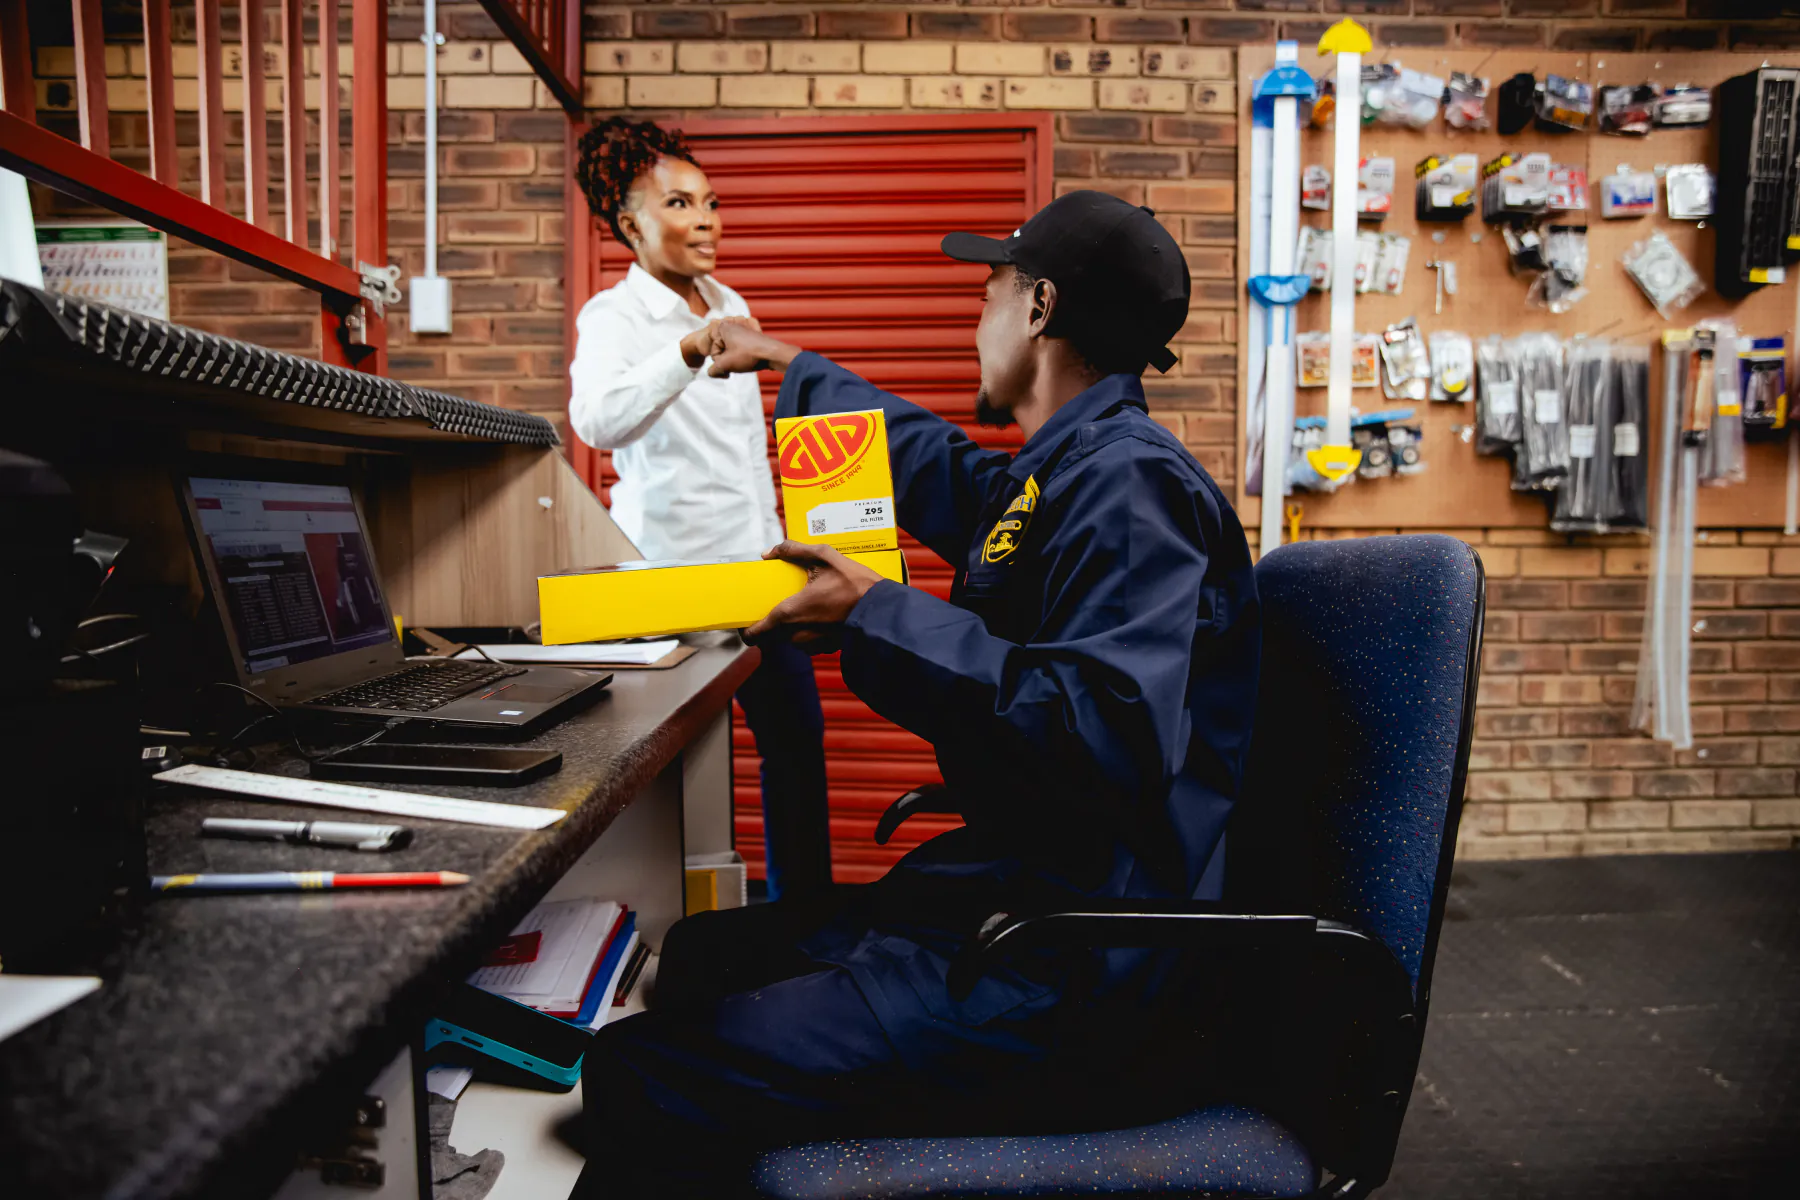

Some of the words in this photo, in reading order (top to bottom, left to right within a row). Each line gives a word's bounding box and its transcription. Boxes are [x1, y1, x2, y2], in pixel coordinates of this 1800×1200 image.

[780, 415, 868, 479] GUD
[821, 478, 845, 492] SINCE
[846, 464, 862, 479] 1949
[864, 507, 883, 515] Z95
